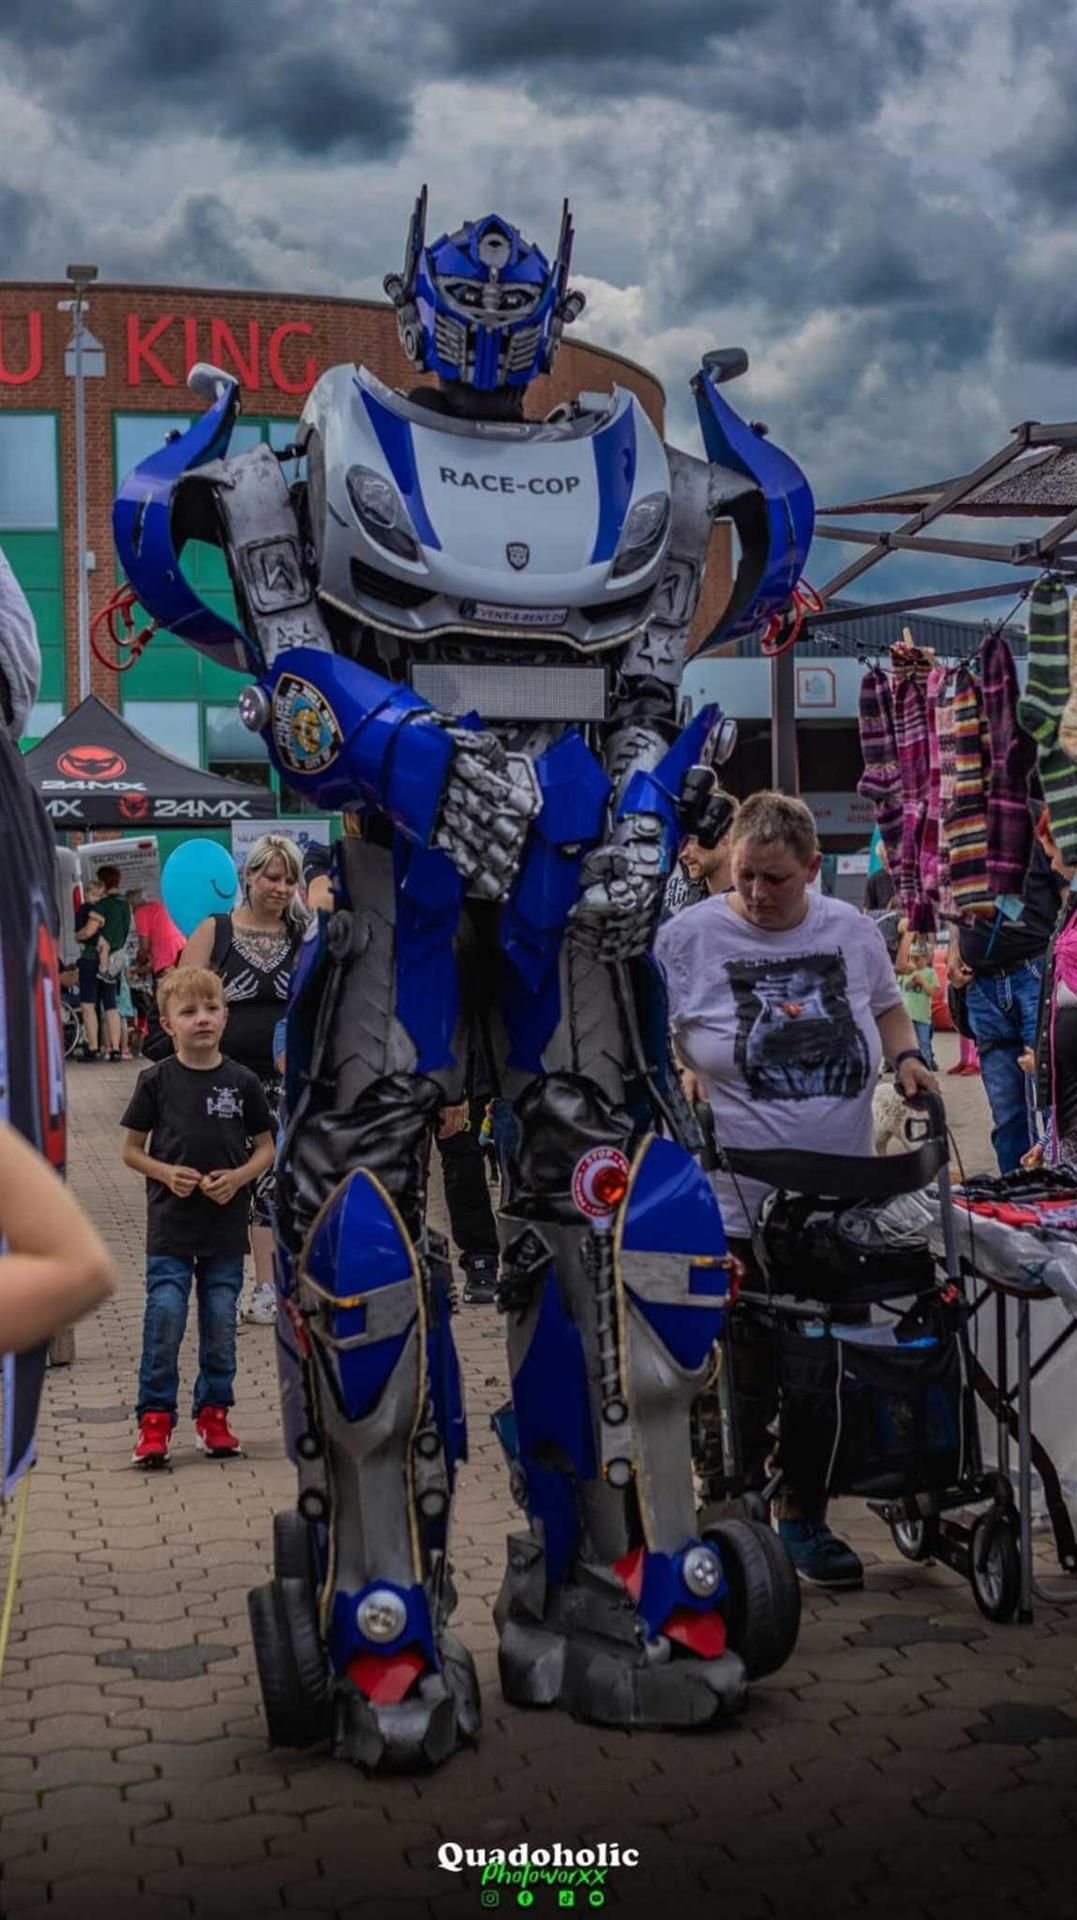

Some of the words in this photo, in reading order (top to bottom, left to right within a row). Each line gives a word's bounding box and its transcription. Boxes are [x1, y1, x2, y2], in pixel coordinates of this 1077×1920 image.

[125, 313, 317, 394] KING
[439, 466, 580, 495] RACE-COP
[41, 780, 148, 791] 24MX
[153, 800, 252, 818] 24MX
[585, 1150, 614, 1165] STOP
